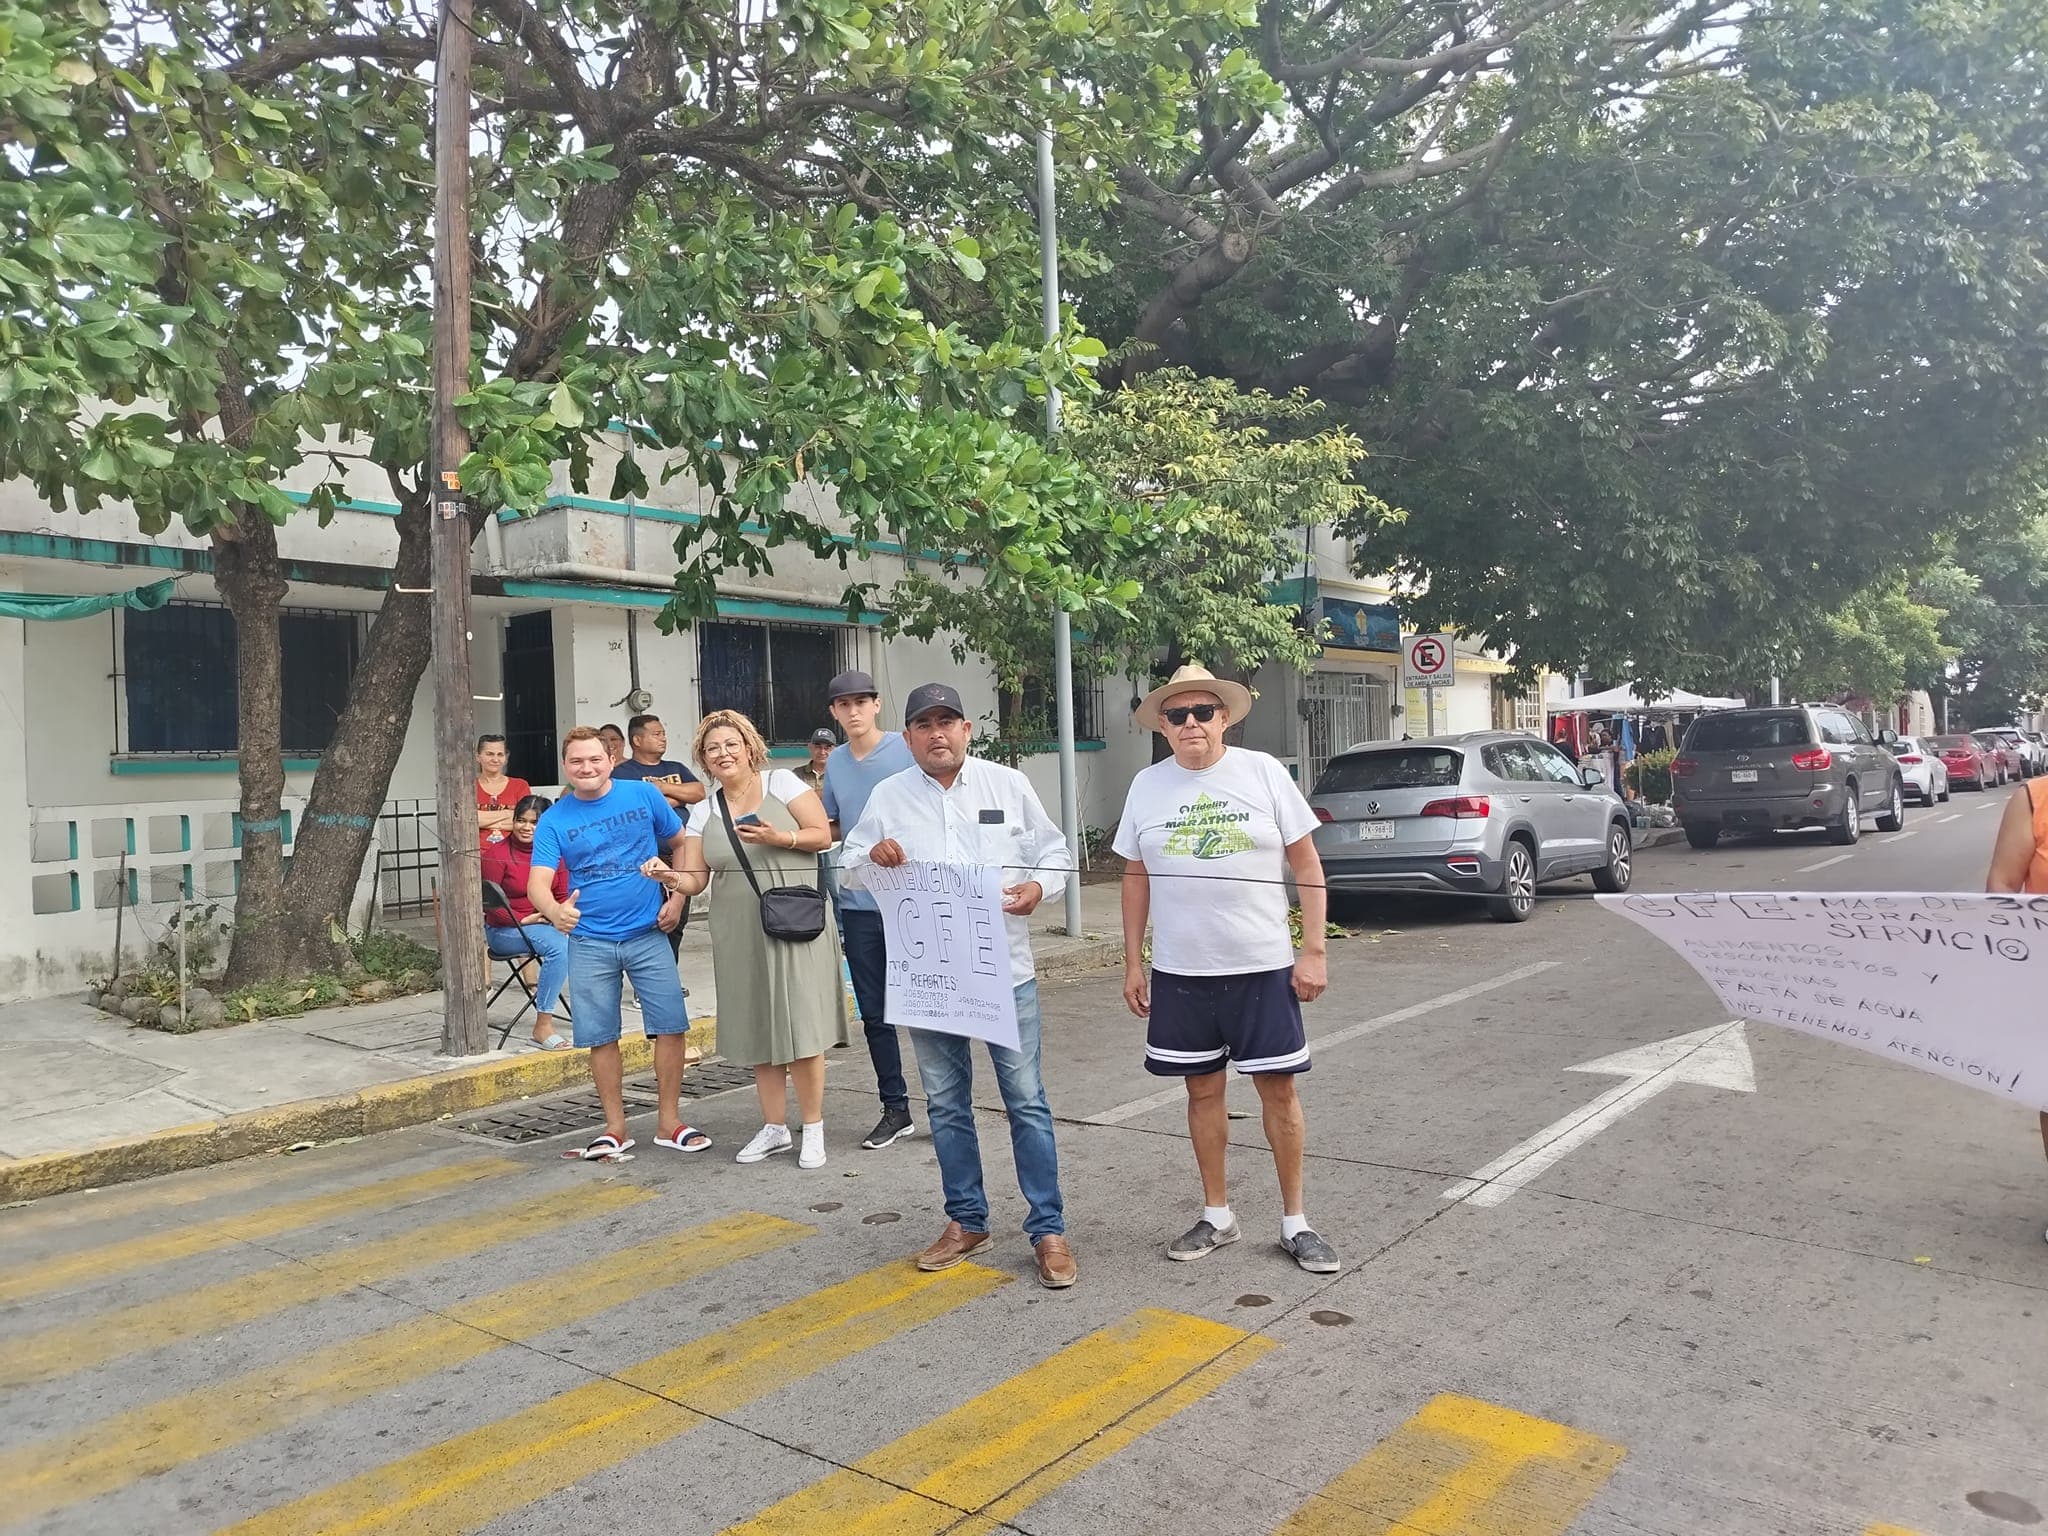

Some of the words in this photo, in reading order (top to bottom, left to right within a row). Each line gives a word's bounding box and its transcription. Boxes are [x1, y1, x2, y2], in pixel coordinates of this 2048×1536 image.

[1421, 645, 1435, 666] E
[1191, 801, 1228, 812] Fidelity
[1165, 812, 1249, 829] MARATHON
[867, 859, 984, 899] ATENCION
[1820, 897, 1897, 909] MAS
[1921, 896, 1977, 910] DE
[1825, 911, 1953, 923] HORAS
[897, 897, 997, 977] CFE
[1827, 922, 2030, 962] SERVICIO
[1684, 938, 1843, 957] ALIMENTOS
[1921, 970, 1940, 985] Y
[1714, 978, 1798, 1000] FALTA
[1857, 1000, 1924, 1023] AGUA
[1772, 1008, 1872, 1041] TENEMOS
